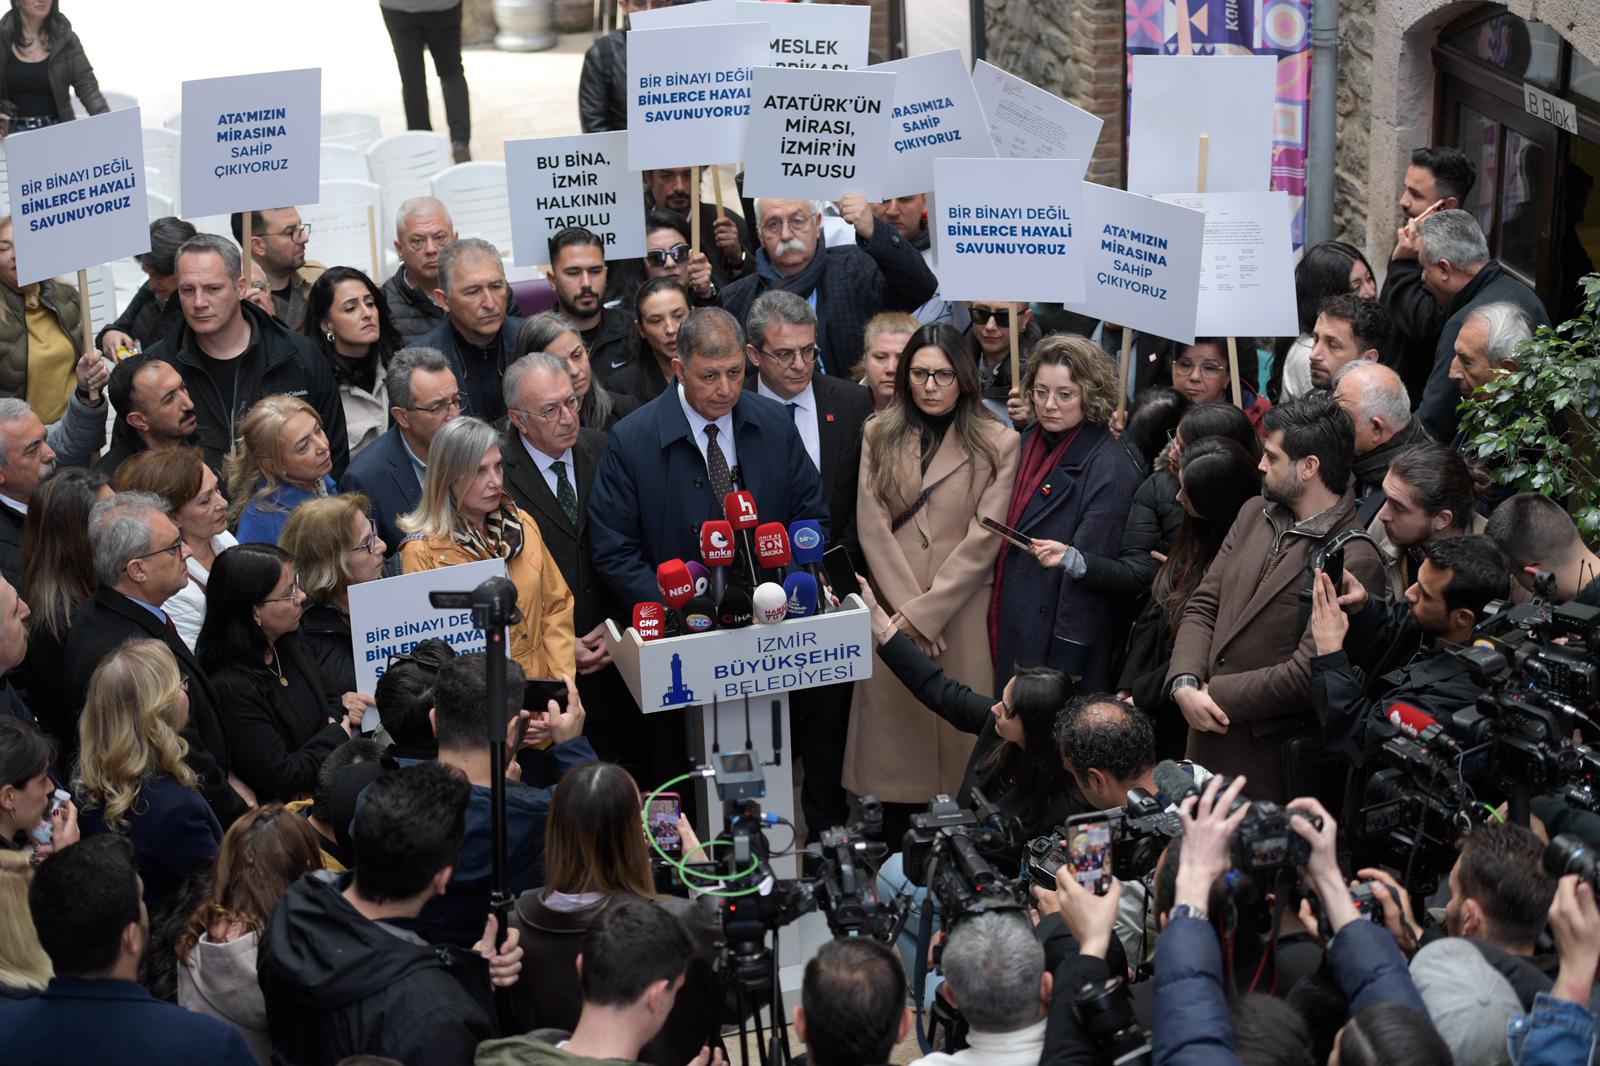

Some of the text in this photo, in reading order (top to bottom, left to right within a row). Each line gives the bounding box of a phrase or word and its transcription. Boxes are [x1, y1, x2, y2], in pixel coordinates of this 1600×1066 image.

[769, 38, 838, 55] MESLEK
[640, 74, 661, 88] BİR
[666, 72, 710, 86] BİNAYI
[638, 91, 705, 105] BİNLERCE
[763, 94, 881, 114] ATATÜRK'ÜN
[217, 108, 286, 125] ATA'MIZIN
[645, 105, 750, 122] SAVUNUYORUZ
[1528, 92, 1571, 131] B Blok
[785, 115, 855, 137] MİRASI,
[902, 114, 940, 133] SAHİP
[217, 125, 286, 142] MİRASINA
[894, 129, 962, 154] ÇIKIYORUZ
[231, 141, 272, 158] SAHİP
[780, 136, 855, 157] İZMİR'İN
[214, 158, 288, 179] ÇIKIYORUZ
[537, 150, 610, 169] BU BİNA,
[21, 157, 133, 196] BİR BİNAYI DEĞİL
[552, 170, 598, 188] İZMİR
[781, 162, 855, 179] TAPUSU
[21, 173, 136, 215] BİNLERCE HAYALİ
[536, 191, 616, 210] HALKININ
[30, 196, 131, 232] SAVUNUYORUZ
[544, 212, 610, 229] TAPULU
[948, 204, 1070, 220] BİR BİNAYI DEĞİL
[947, 221, 1072, 238] BİNLERCE HAYALİ
[1102, 224, 1168, 250] ATA'MIZIN
[955, 242, 1066, 255] SAVUNUYORUZ
[1101, 239, 1167, 267] MİRASINA
[1113, 259, 1153, 278] SAHİP
[1097, 272, 1167, 300] ÇIKIYORUZ
[669, 583, 691, 597] NEO
[366, 627, 390, 644] BİR
[394, 617, 444, 638] BİNAYI
[639, 619, 659, 628] CHP
[757, 631, 817, 653] İZMİR
[714, 643, 861, 679] BÜYÜKŞEHİR
[725, 661, 853, 697] BELEDİYESİ
